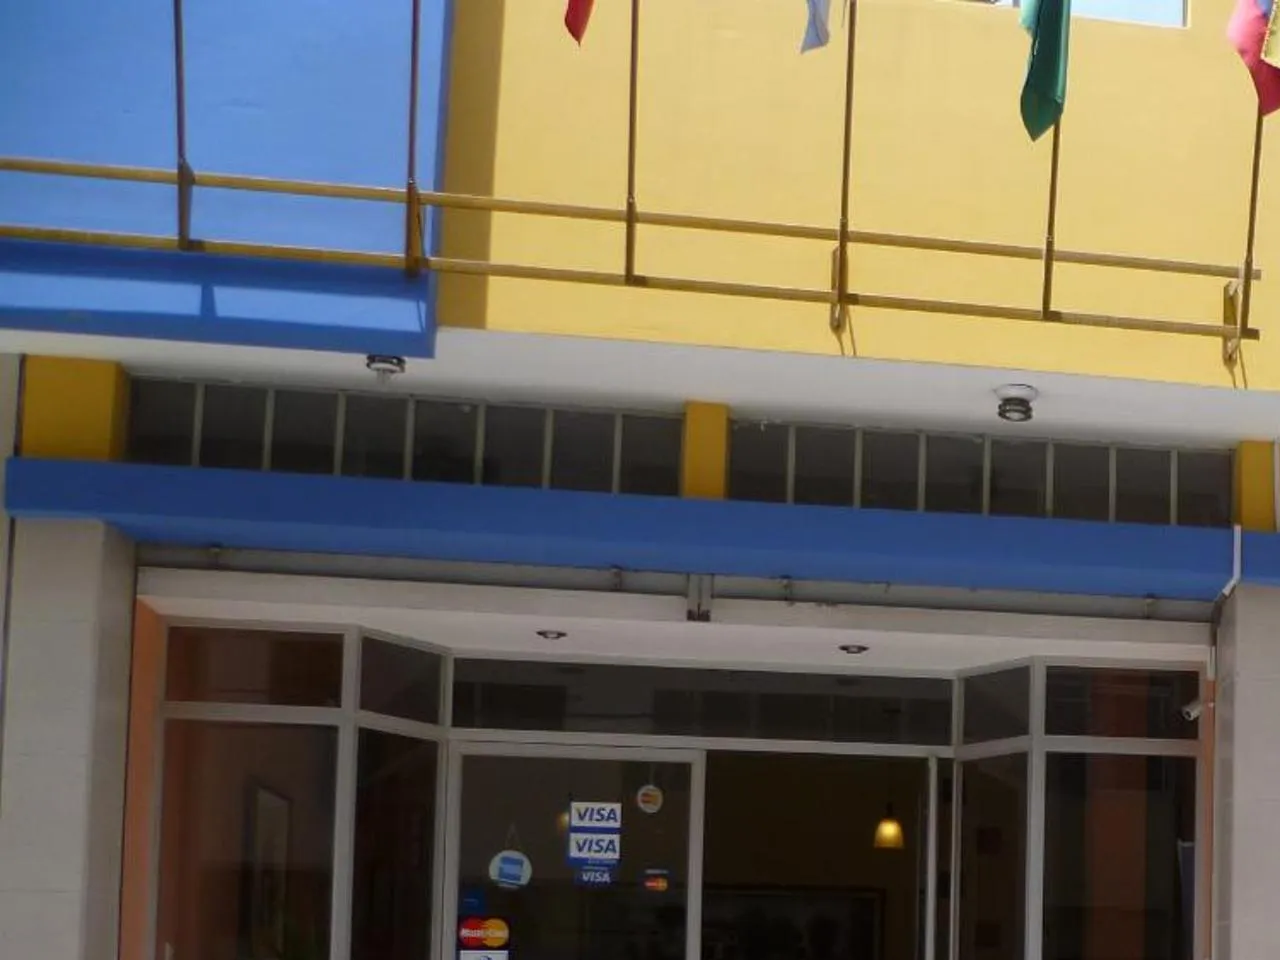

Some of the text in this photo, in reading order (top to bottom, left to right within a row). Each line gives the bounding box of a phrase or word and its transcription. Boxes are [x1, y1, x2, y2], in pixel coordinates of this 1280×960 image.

[576, 807, 618, 823] VISA
[575, 838, 617, 854] VISA
[582, 871, 611, 883] VISA
